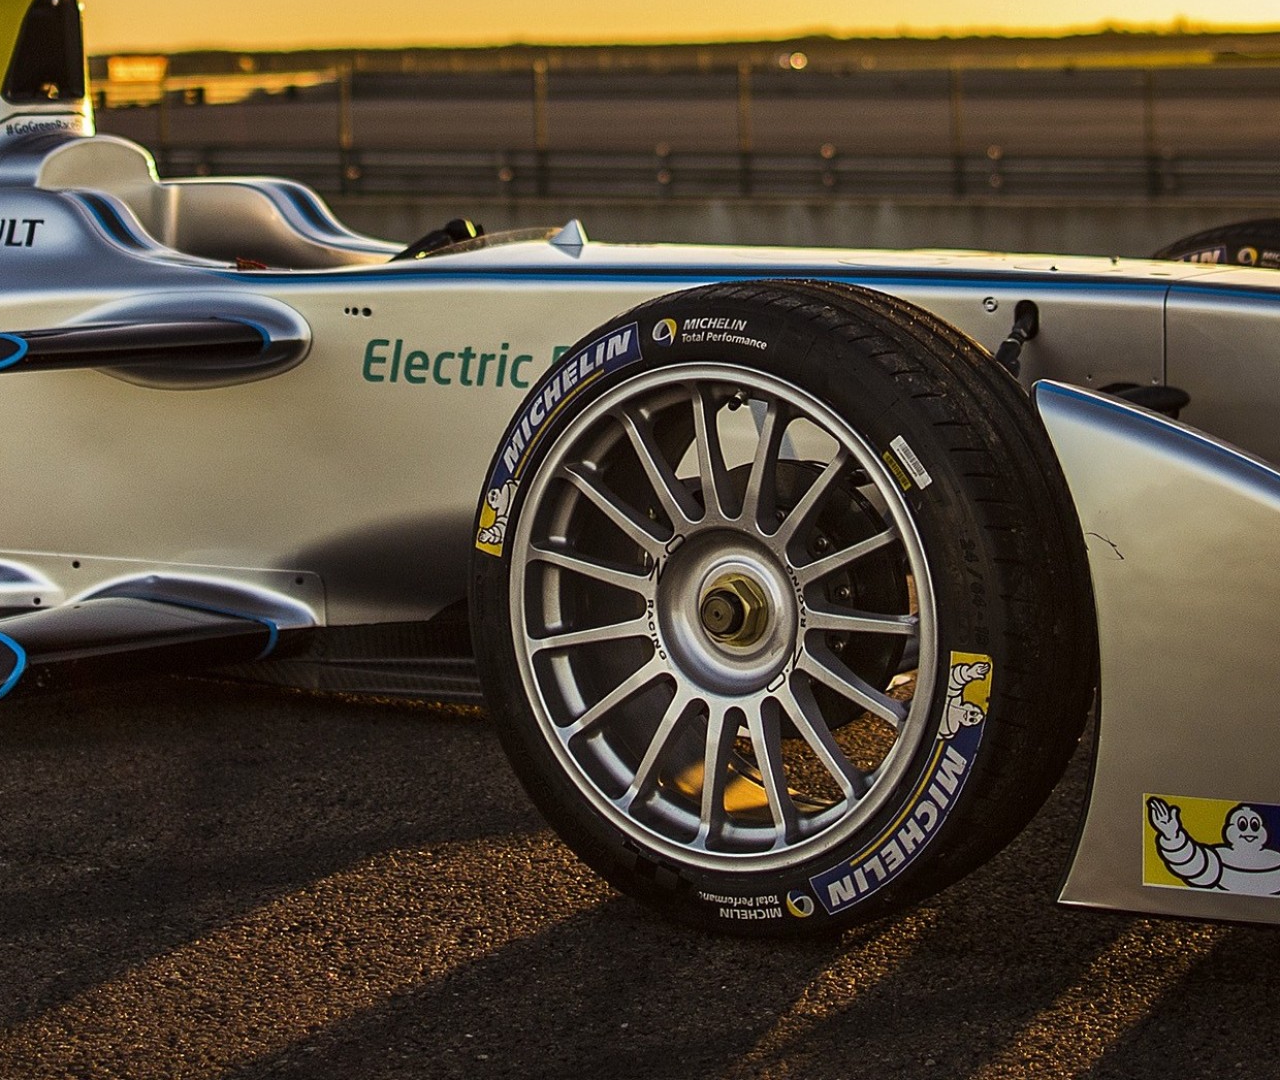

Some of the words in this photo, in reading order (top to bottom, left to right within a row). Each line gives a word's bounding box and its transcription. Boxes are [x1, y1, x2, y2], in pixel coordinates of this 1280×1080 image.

[681, 331, 705, 343] Total
[706, 331, 768, 351] Performance
[682, 317, 748, 332] MICHELIN
[362, 338, 533, 390] Electric
[501, 329, 633, 474] MICHELIN
[646, 599, 668, 661] RACING
[826, 745, 968, 908] MICHELIN
[719, 906, 783, 920] MICHELIN
[755, 894, 780, 907] Total
